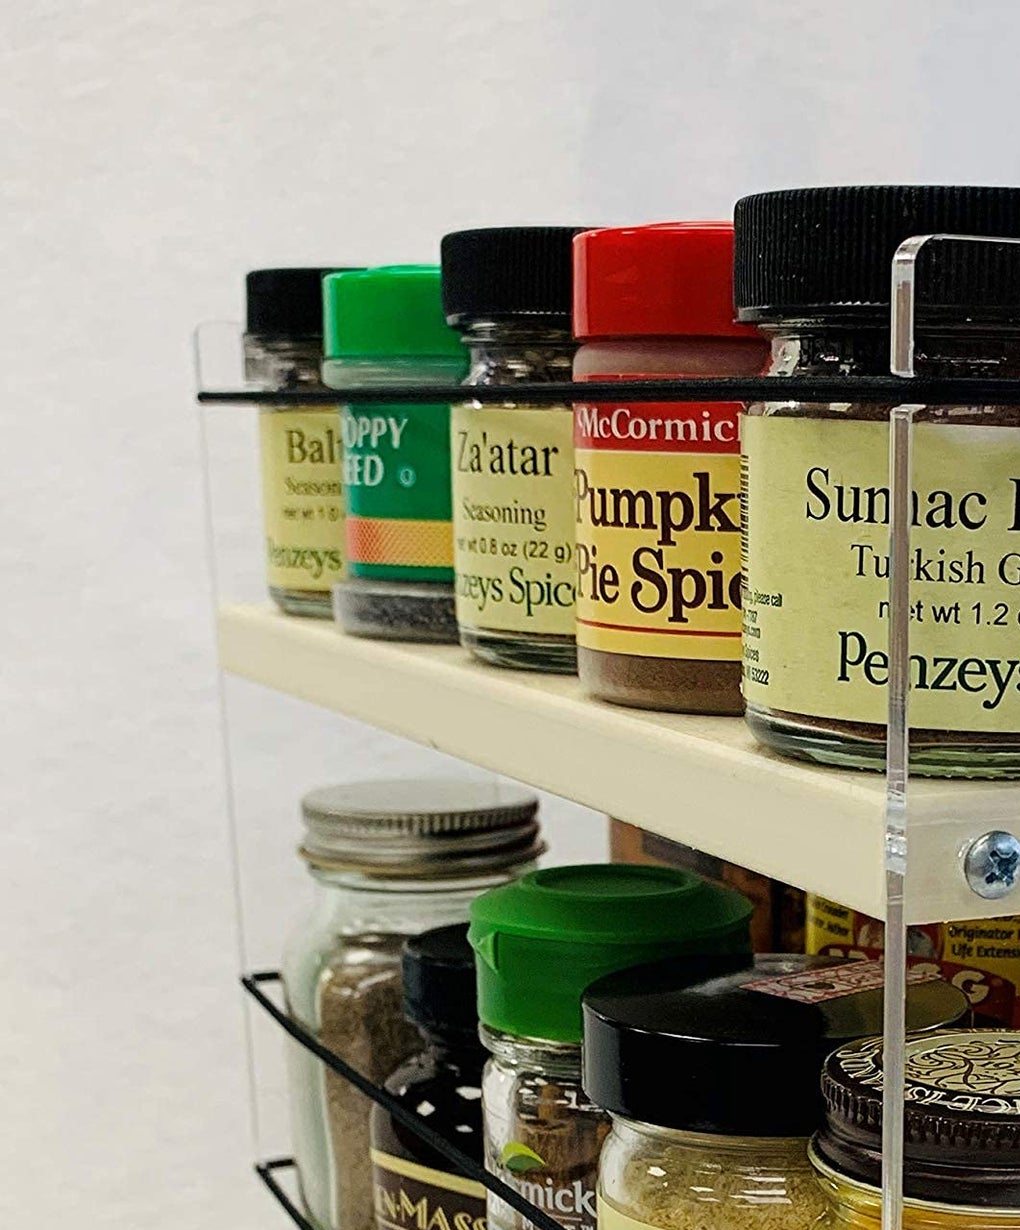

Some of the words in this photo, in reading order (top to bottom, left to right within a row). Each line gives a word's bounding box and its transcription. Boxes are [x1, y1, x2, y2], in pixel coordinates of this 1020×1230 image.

[286, 430, 341, 463] Bal
[457, 430, 559, 477] Za'atar
[461, 498, 548, 532] Seasoning
[573, 467, 744, 546] Pumpk
[501, 541, 518, 557] oz
[522, 541, 549, 560] (22
[554, 541, 573, 564] g)
[850, 543, 986, 584] Tukish
[574, 543, 620, 605] Pie
[931, 602, 961, 625] wt
[970, 602, 1009, 626] 1.2
